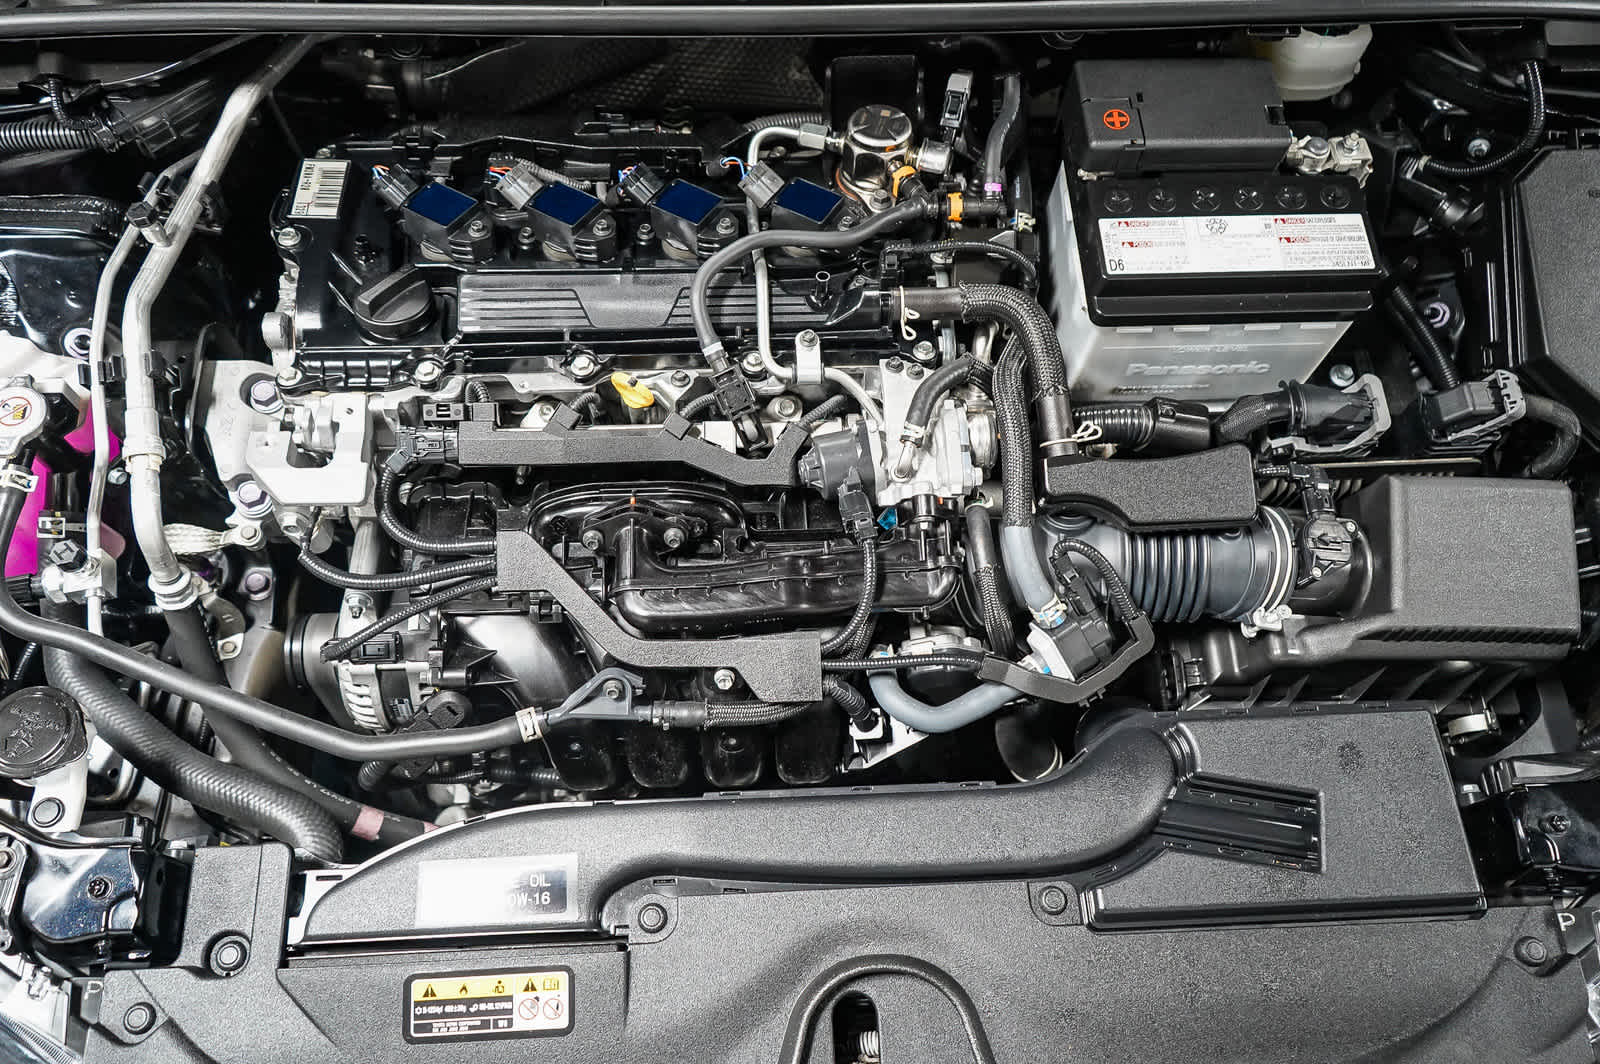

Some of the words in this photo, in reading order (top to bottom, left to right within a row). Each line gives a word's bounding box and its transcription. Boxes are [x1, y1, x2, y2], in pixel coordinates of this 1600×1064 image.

[1109, 259, 1125, 272] D6
[1125, 361, 1271, 376] Panasonic
[529, 873, 551, 887] OIL
[1557, 912, 1576, 931] P
[85, 981, 103, 1000] P
